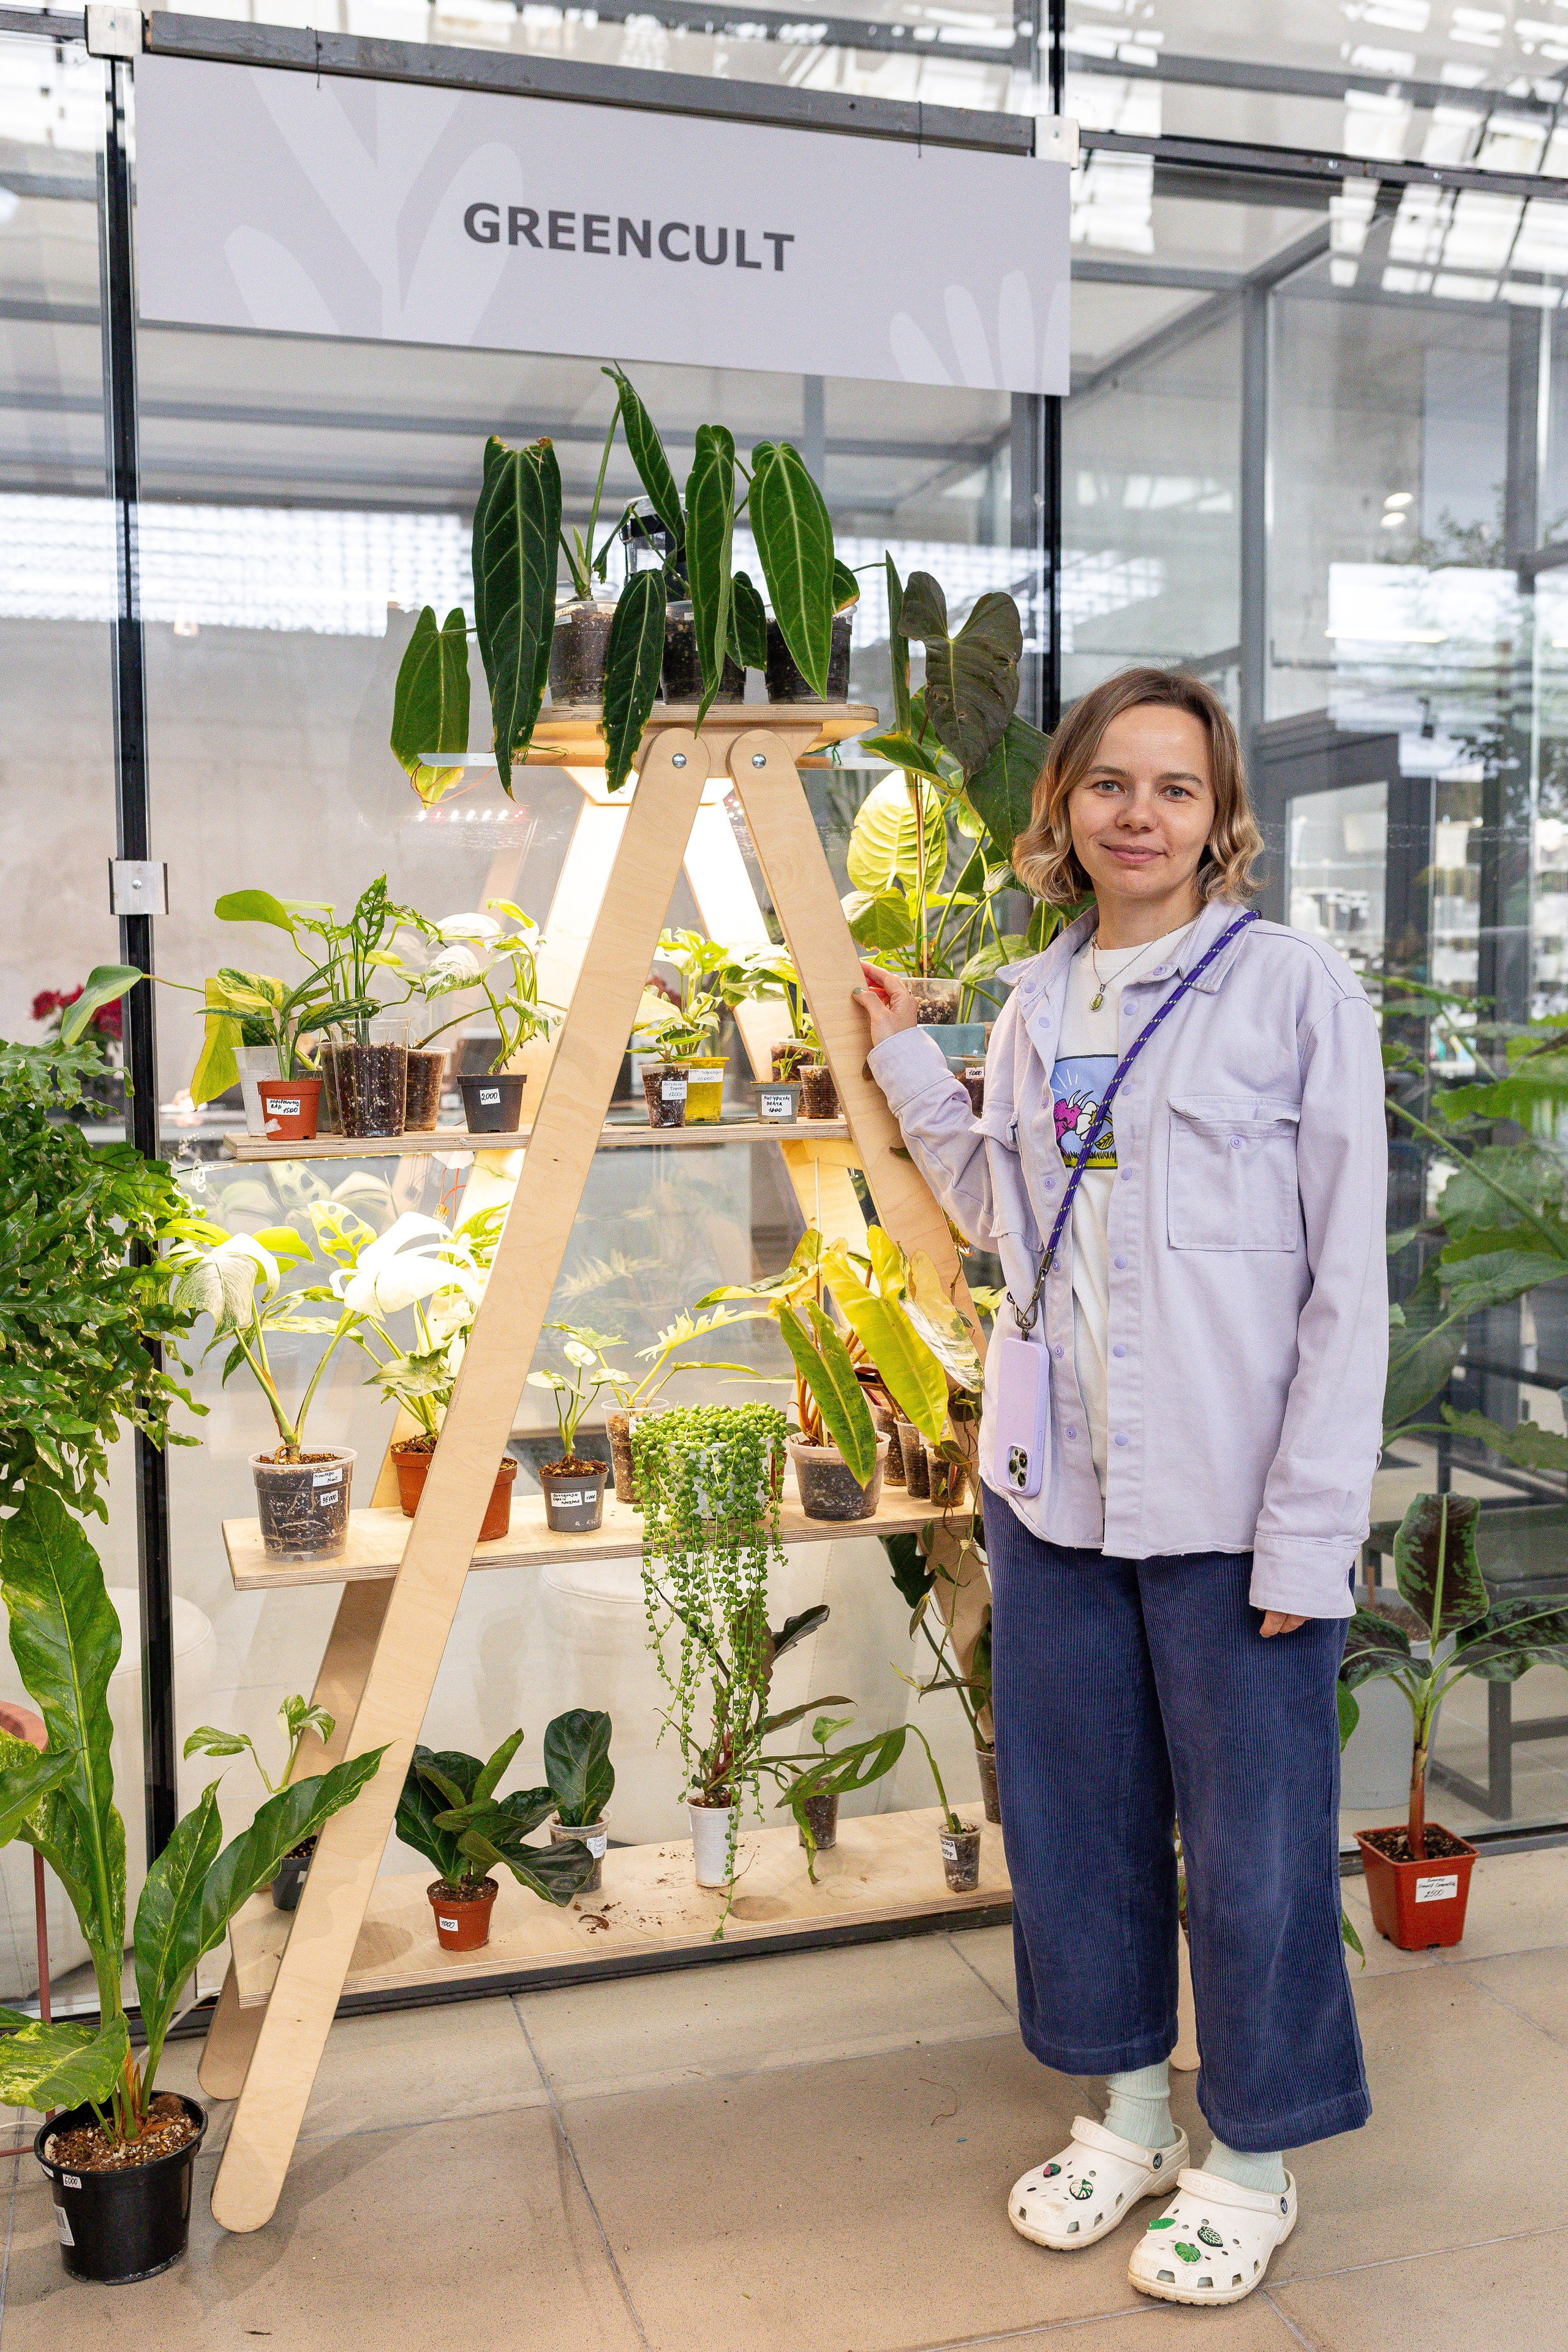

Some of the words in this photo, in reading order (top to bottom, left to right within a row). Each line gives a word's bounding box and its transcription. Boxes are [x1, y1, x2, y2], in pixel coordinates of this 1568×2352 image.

[464, 202, 794, 271] GREENCULT
[481, 1092, 497, 1101] 2000
[441, 1920, 456, 1929] 1000
[64, 2177, 78, 2185] 6000
